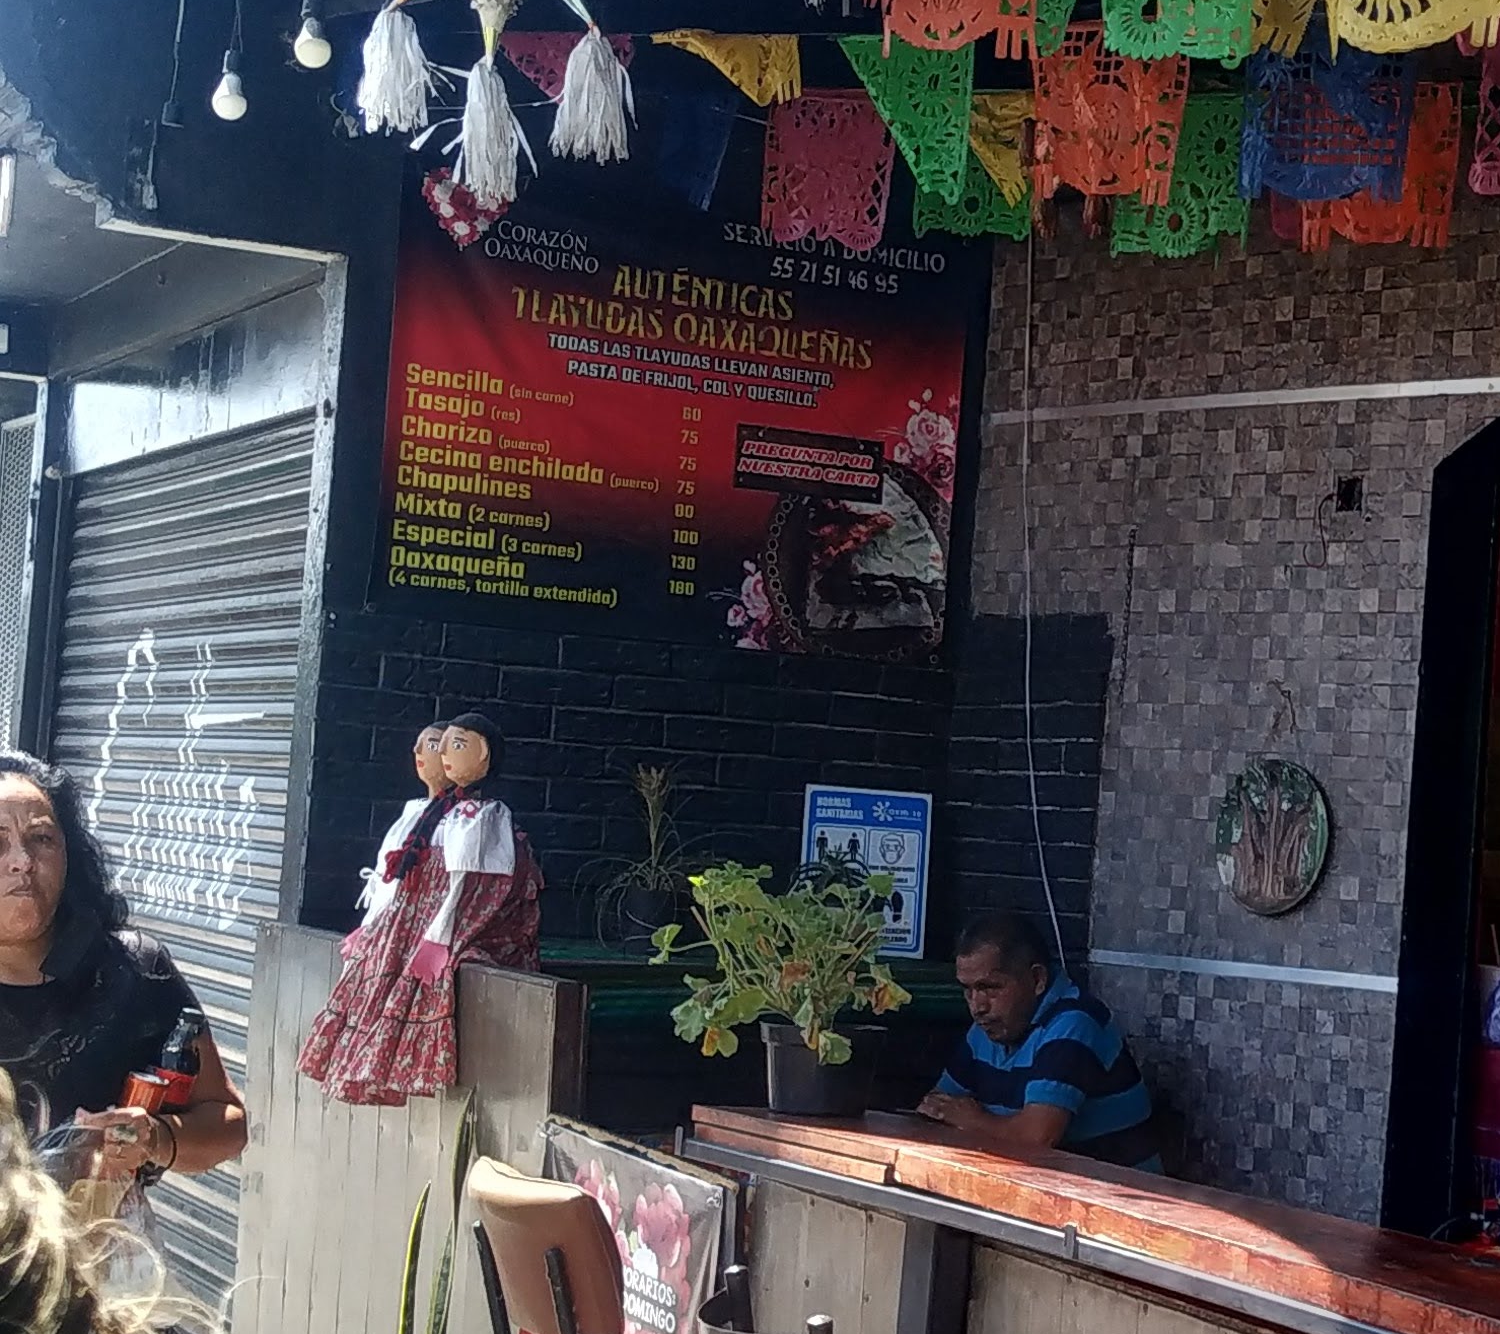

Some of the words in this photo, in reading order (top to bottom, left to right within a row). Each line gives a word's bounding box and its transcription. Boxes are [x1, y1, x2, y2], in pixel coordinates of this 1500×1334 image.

[498, 220, 588, 252] CORAZÓN
[612, 264, 793, 321] AUTÉNTICAS
[770, 256, 795, 279] 55
[799, 260, 817, 283] 21
[822, 265, 840, 287] 51
[848, 270, 868, 291] 46
[875, 272, 899, 295] 95
[511, 284, 664, 340] TLAYUDAS
[674, 313, 872, 370] OAXAQUEÑAS
[549, 333, 600, 354] TODAS
[603, 342, 631, 359] LAS
[635, 346, 711, 371] TLAYUDAS
[715, 357, 768, 378] LLEVAN
[772, 365, 835, 389] ASIENTO,
[568, 360, 618, 381] PASTA
[622, 368, 641, 384] DE
[645, 371, 699, 394] FRIJOL,
[703, 379, 730, 397] COL
[734, 383, 744, 398] Y
[747, 385, 818, 407] QUESILLO.
[406, 363, 504, 395] Sencilla
[509, 384, 533, 401] (sin
[535, 390, 575, 407] carne)
[405, 387, 485, 419] Tasajo
[490, 406, 522, 424] (res)
[681, 429, 699, 445] 75
[402, 415, 493, 446] Chorizo
[498, 434, 551, 455] (puerco)
[679, 455, 697, 471] 75
[741, 440, 838, 465] PREGUNTA
[838, 453, 874, 470] POR
[396, 465, 532, 500] Chapulines
[399, 440, 482, 469] Cecina
[489, 454, 605, 485] enchilada
[610, 472, 660, 493] (puerco)
[676, 479, 695, 496] 75
[737, 457, 822, 481] NUESTRA
[824, 468, 880, 488] CARTA
[395, 492, 462, 519] Mixta
[468, 503, 486, 524] (2
[489, 511, 551, 532] carnes)
[673, 529, 700, 546] 100
[390, 546, 526, 579] Oaxaqueña
[392, 519, 495, 550] Especial
[501, 534, 519, 554] (3
[522, 541, 583, 561] carnes)
[671, 554, 696, 571] 130
[388, 567, 407, 587] (4
[410, 574, 471, 594] carnes,
[475, 580, 530, 598] tortilla
[533, 587, 618, 608] extendida)
[668, 580, 695, 596] 180
